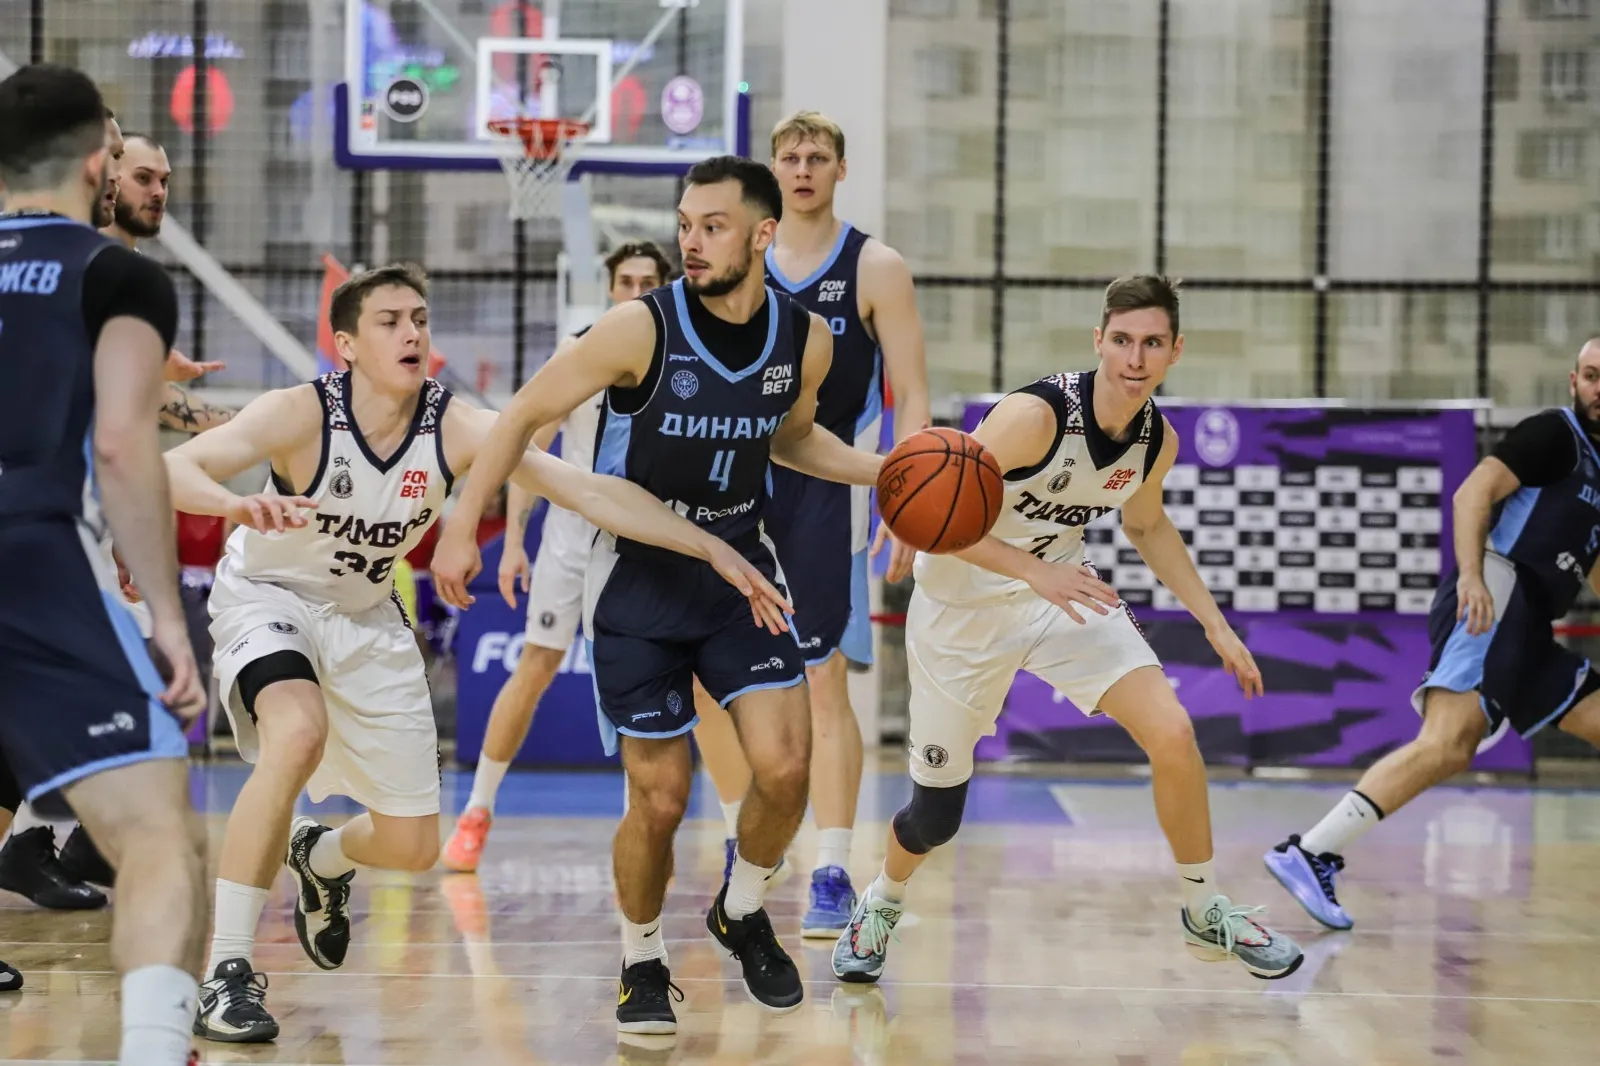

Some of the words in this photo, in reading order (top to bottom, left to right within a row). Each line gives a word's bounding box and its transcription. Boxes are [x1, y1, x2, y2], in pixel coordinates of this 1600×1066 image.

[819, 280, 846, 291] FON
[818, 291, 845, 302] BET
[762, 364, 792, 381] FON
[762, 379, 793, 395] BET
[658, 412, 778, 439] ДИНАМ
[708, 450, 736, 491] 4
[1110, 469, 1136, 479] FON
[400, 485, 427, 498] BET
[1102, 480, 1130, 490] BET
[329, 551, 397, 584] 38
